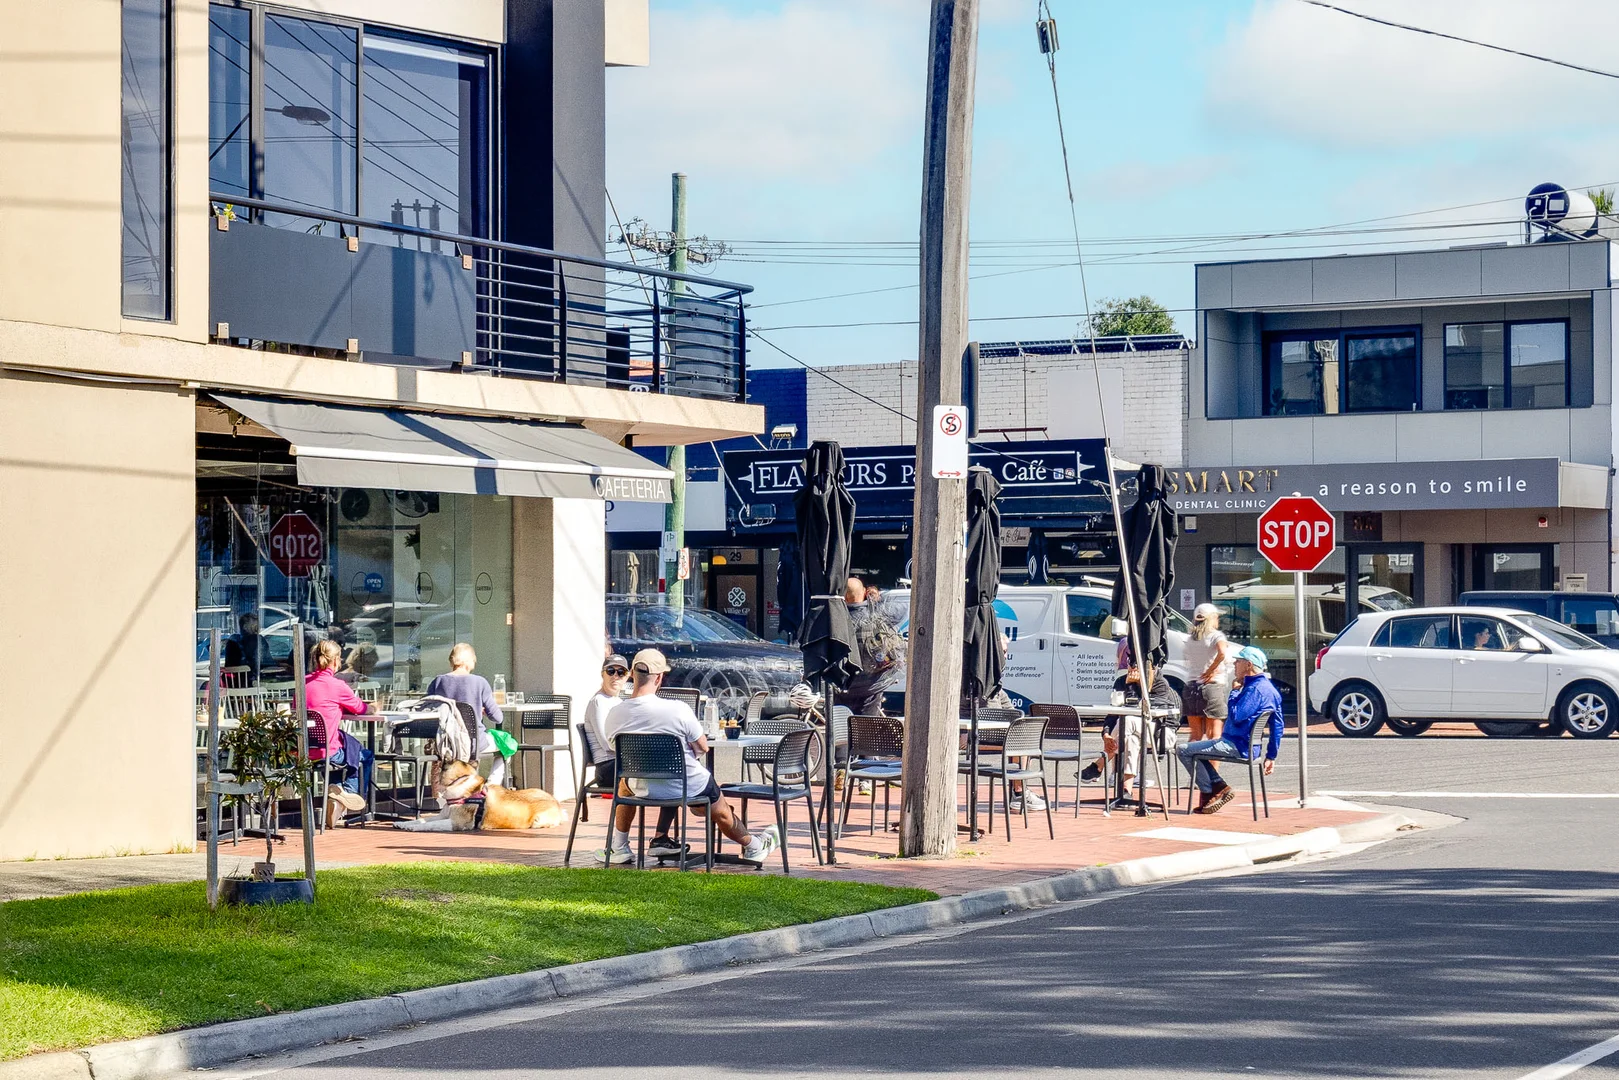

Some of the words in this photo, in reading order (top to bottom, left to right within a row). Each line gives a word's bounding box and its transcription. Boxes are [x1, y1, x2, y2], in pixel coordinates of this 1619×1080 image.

[758, 463, 887, 488] FLAURS
[1002, 459, 1047, 482] Café
[595, 477, 666, 499] CAFETERIA
[1319, 484, 1329, 496] a
[1341, 482, 1417, 496] reason
[1429, 479, 1451, 494] to
[1464, 475, 1527, 493] smile
[1176, 501, 1220, 509] DENTAL
[1225, 499, 1267, 508] CLINIC
[1263, 520, 1330, 548] STOP
[730, 551, 742, 562] 29
[741, 607, 750, 615] GP
